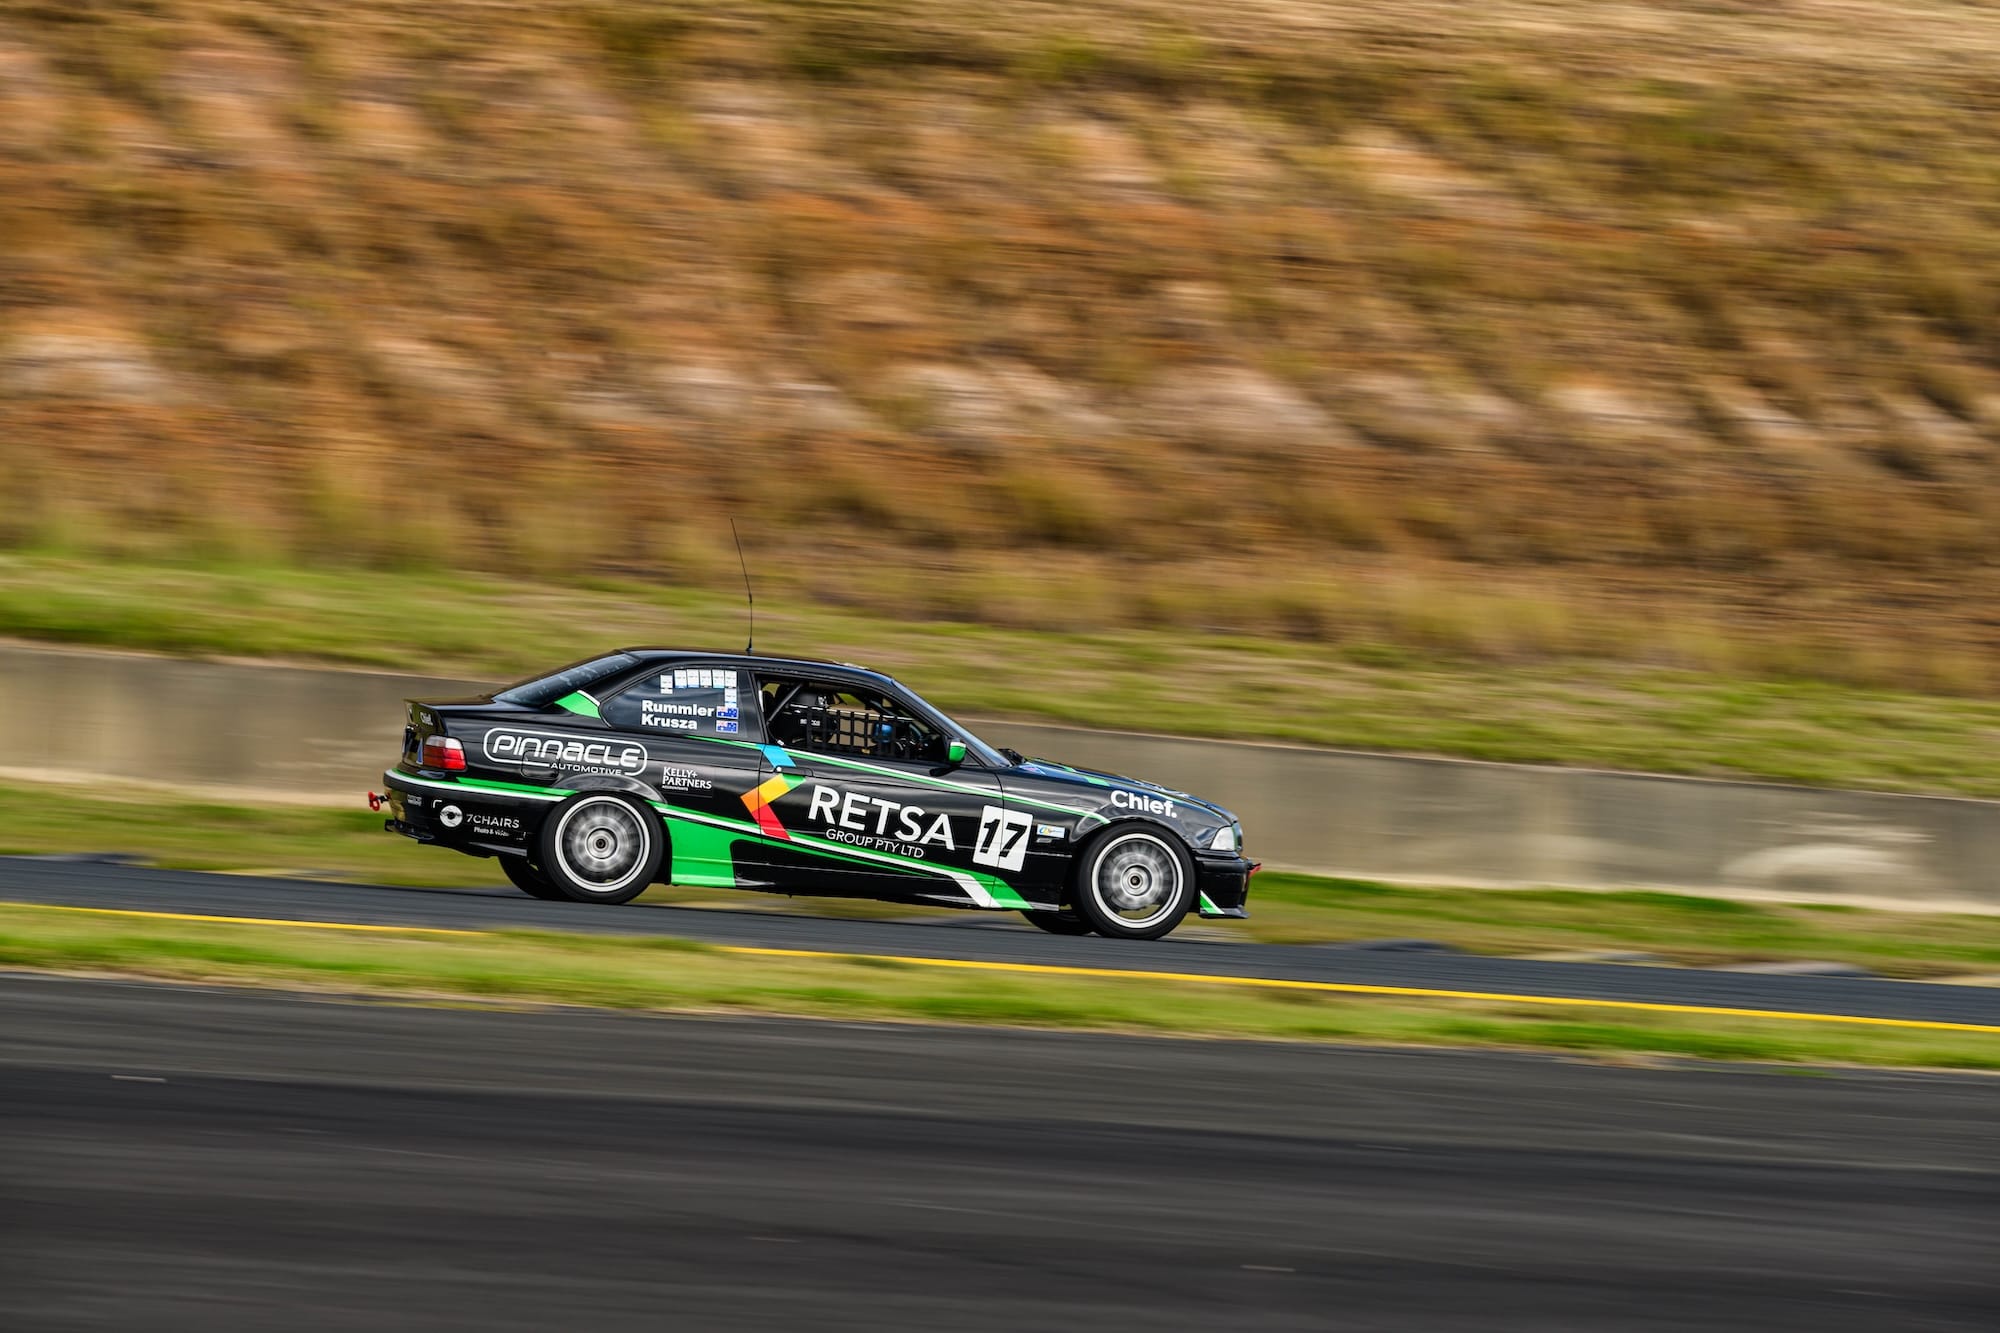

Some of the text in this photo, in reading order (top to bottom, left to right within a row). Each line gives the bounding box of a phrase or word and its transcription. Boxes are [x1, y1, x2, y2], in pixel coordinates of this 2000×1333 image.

[642, 700, 715, 717] Rummler
[641, 713, 698, 730] Krusza
[551, 762, 622, 776] AUTOMOTIVE
[663, 766, 698, 778] KELLY+
[662, 775, 712, 789] PARTNERS
[1110, 790, 1177, 818] Chief.
[466, 813, 520, 829] 7CHAIRS
[808, 785, 955, 851] RETSA
[825, 828, 924, 859] GROUP PTY LTD
[978, 818, 1028, 858] 17
